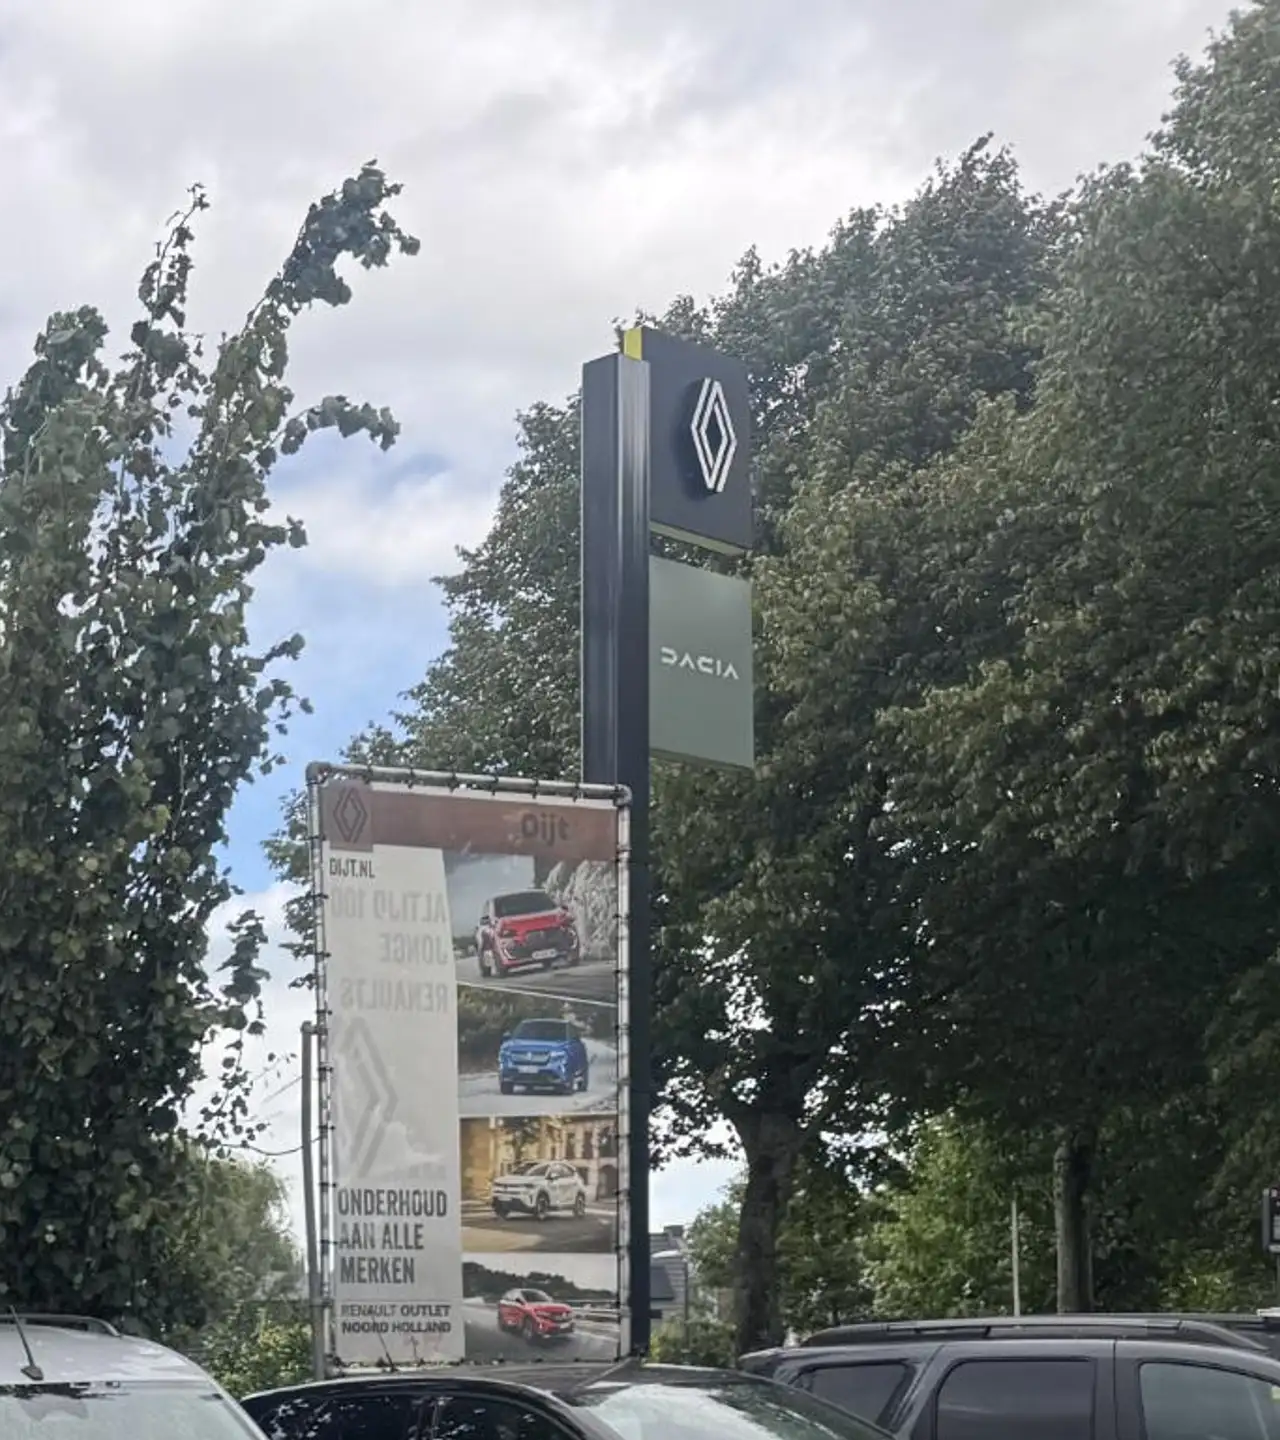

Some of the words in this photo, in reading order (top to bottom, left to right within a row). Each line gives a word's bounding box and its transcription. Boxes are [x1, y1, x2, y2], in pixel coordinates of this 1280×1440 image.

[660, 645, 739, 680] DACIA
[520, 812, 570, 847] Dijt
[329, 856, 376, 879] DIJT.NL
[338, 1187, 448, 1217] ONDERHOUD
[339, 1221, 376, 1250] AAN
[381, 1222, 425, 1250] ALLE
[339, 1256, 416, 1284] MERKEN
[341, 1304, 397, 1317] RENAULT
[400, 1304, 452, 1317] OUTLET
[341, 1321, 389, 1334] NOORD
[392, 1321, 452, 1333] HOLLAND
